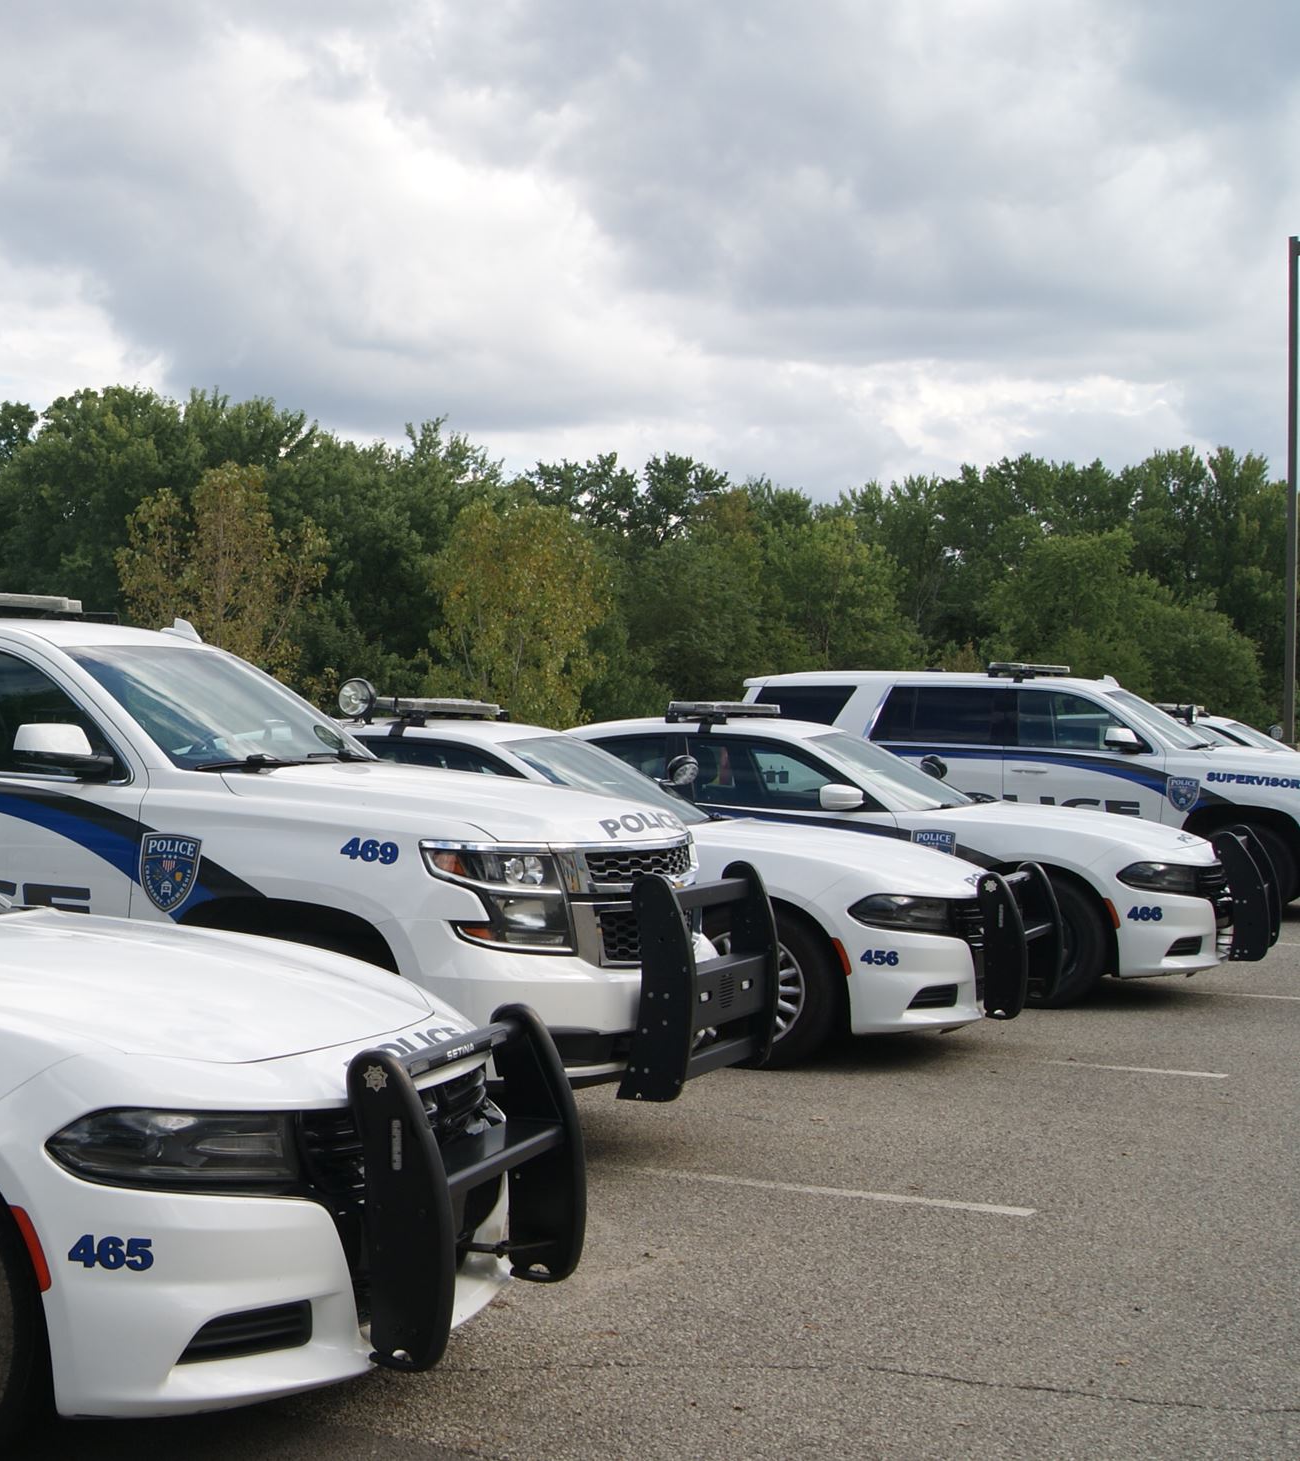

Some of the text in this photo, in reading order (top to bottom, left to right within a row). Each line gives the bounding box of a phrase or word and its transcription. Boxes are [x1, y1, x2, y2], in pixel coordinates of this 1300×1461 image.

[1206, 771, 1300, 789] SUPERVISOR
[916, 832, 952, 844] POLICE
[148, 839, 196, 857] POLICE
[340, 837, 399, 865] 469
[1127, 906, 1162, 921] 466
[860, 949, 899, 966] 456
[446, 1043, 475, 1060] SETINA
[68, 1234, 154, 1272] 465
